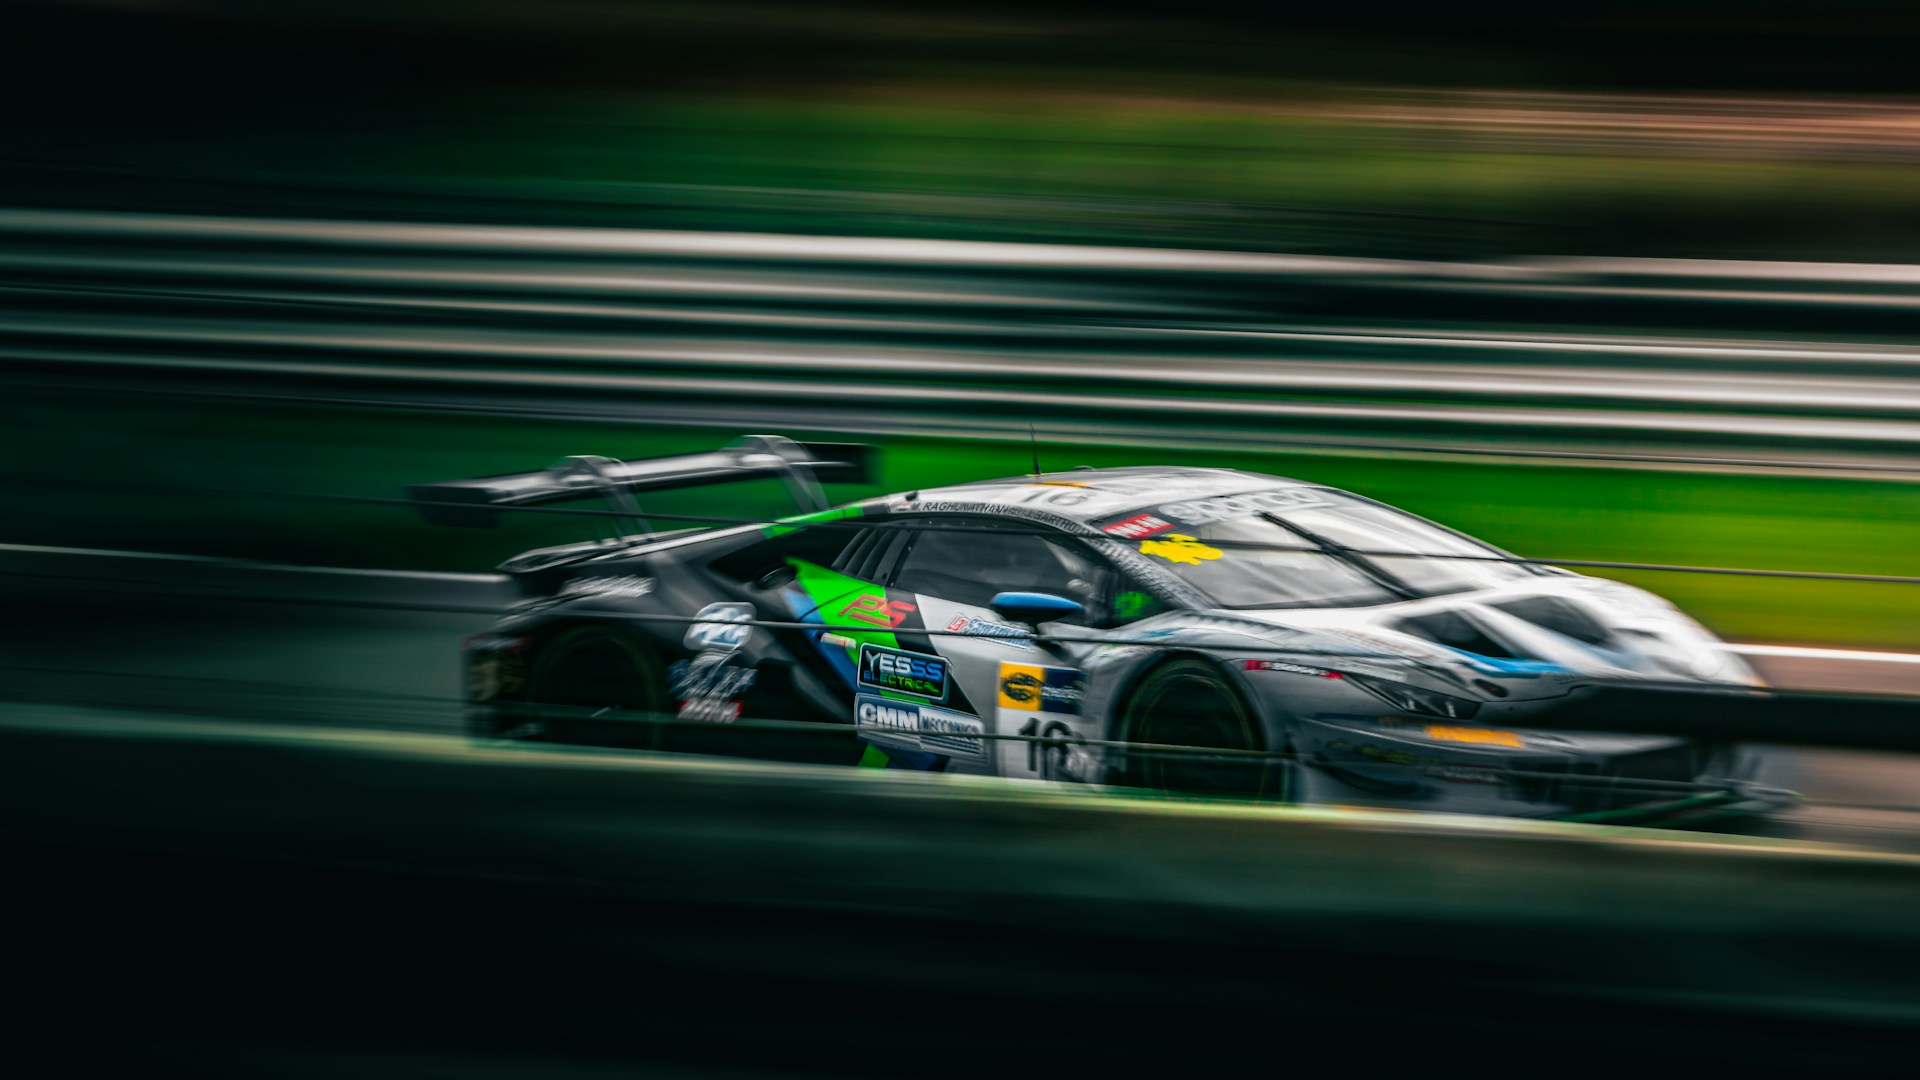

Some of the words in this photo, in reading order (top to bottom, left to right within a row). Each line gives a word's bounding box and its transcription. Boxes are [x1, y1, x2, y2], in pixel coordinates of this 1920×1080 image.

[865, 650, 944, 681] YESSS
[863, 669, 940, 693] ELECTRICAL
[859, 702, 920, 731] CMM
